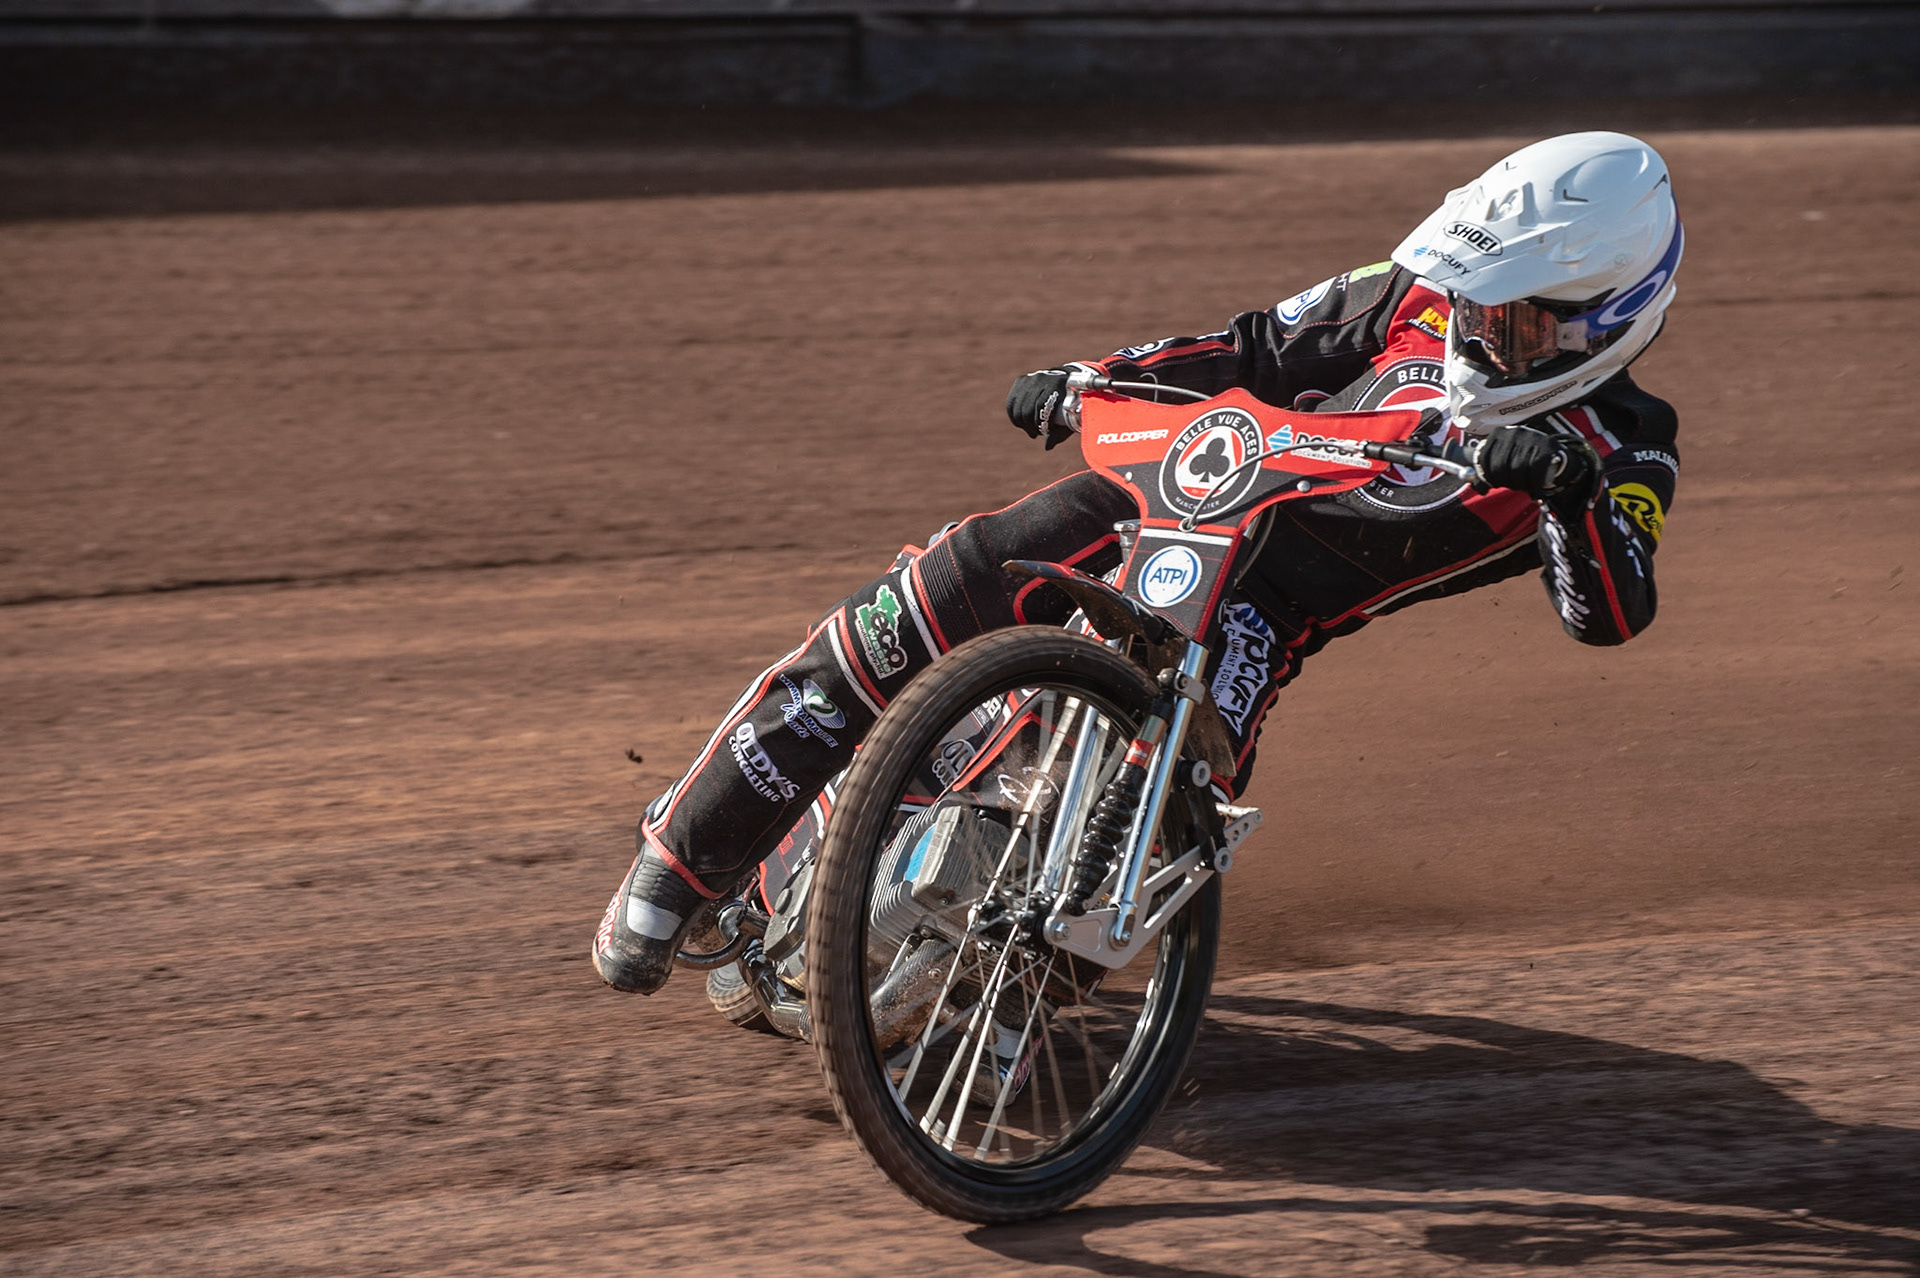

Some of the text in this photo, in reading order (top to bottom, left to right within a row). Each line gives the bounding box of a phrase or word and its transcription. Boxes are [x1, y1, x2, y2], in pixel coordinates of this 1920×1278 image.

[1447, 223, 1499, 252] SHOEI
[1427, 248, 1472, 276] DOCUFY
[1096, 428, 1170, 445] POLCOPPER
[1176, 414, 1258, 456] BELLE VUE ACES
[1291, 447, 1372, 468] DOCUMENT SOLUTIONS
[1149, 566, 1188, 586] ATPI
[868, 627, 893, 673] waste
[870, 610, 907, 669] eco
[805, 717, 837, 748] MALLEE
[728, 735, 781, 803] CONCRETING
[736, 722, 801, 799] OLDY'S
